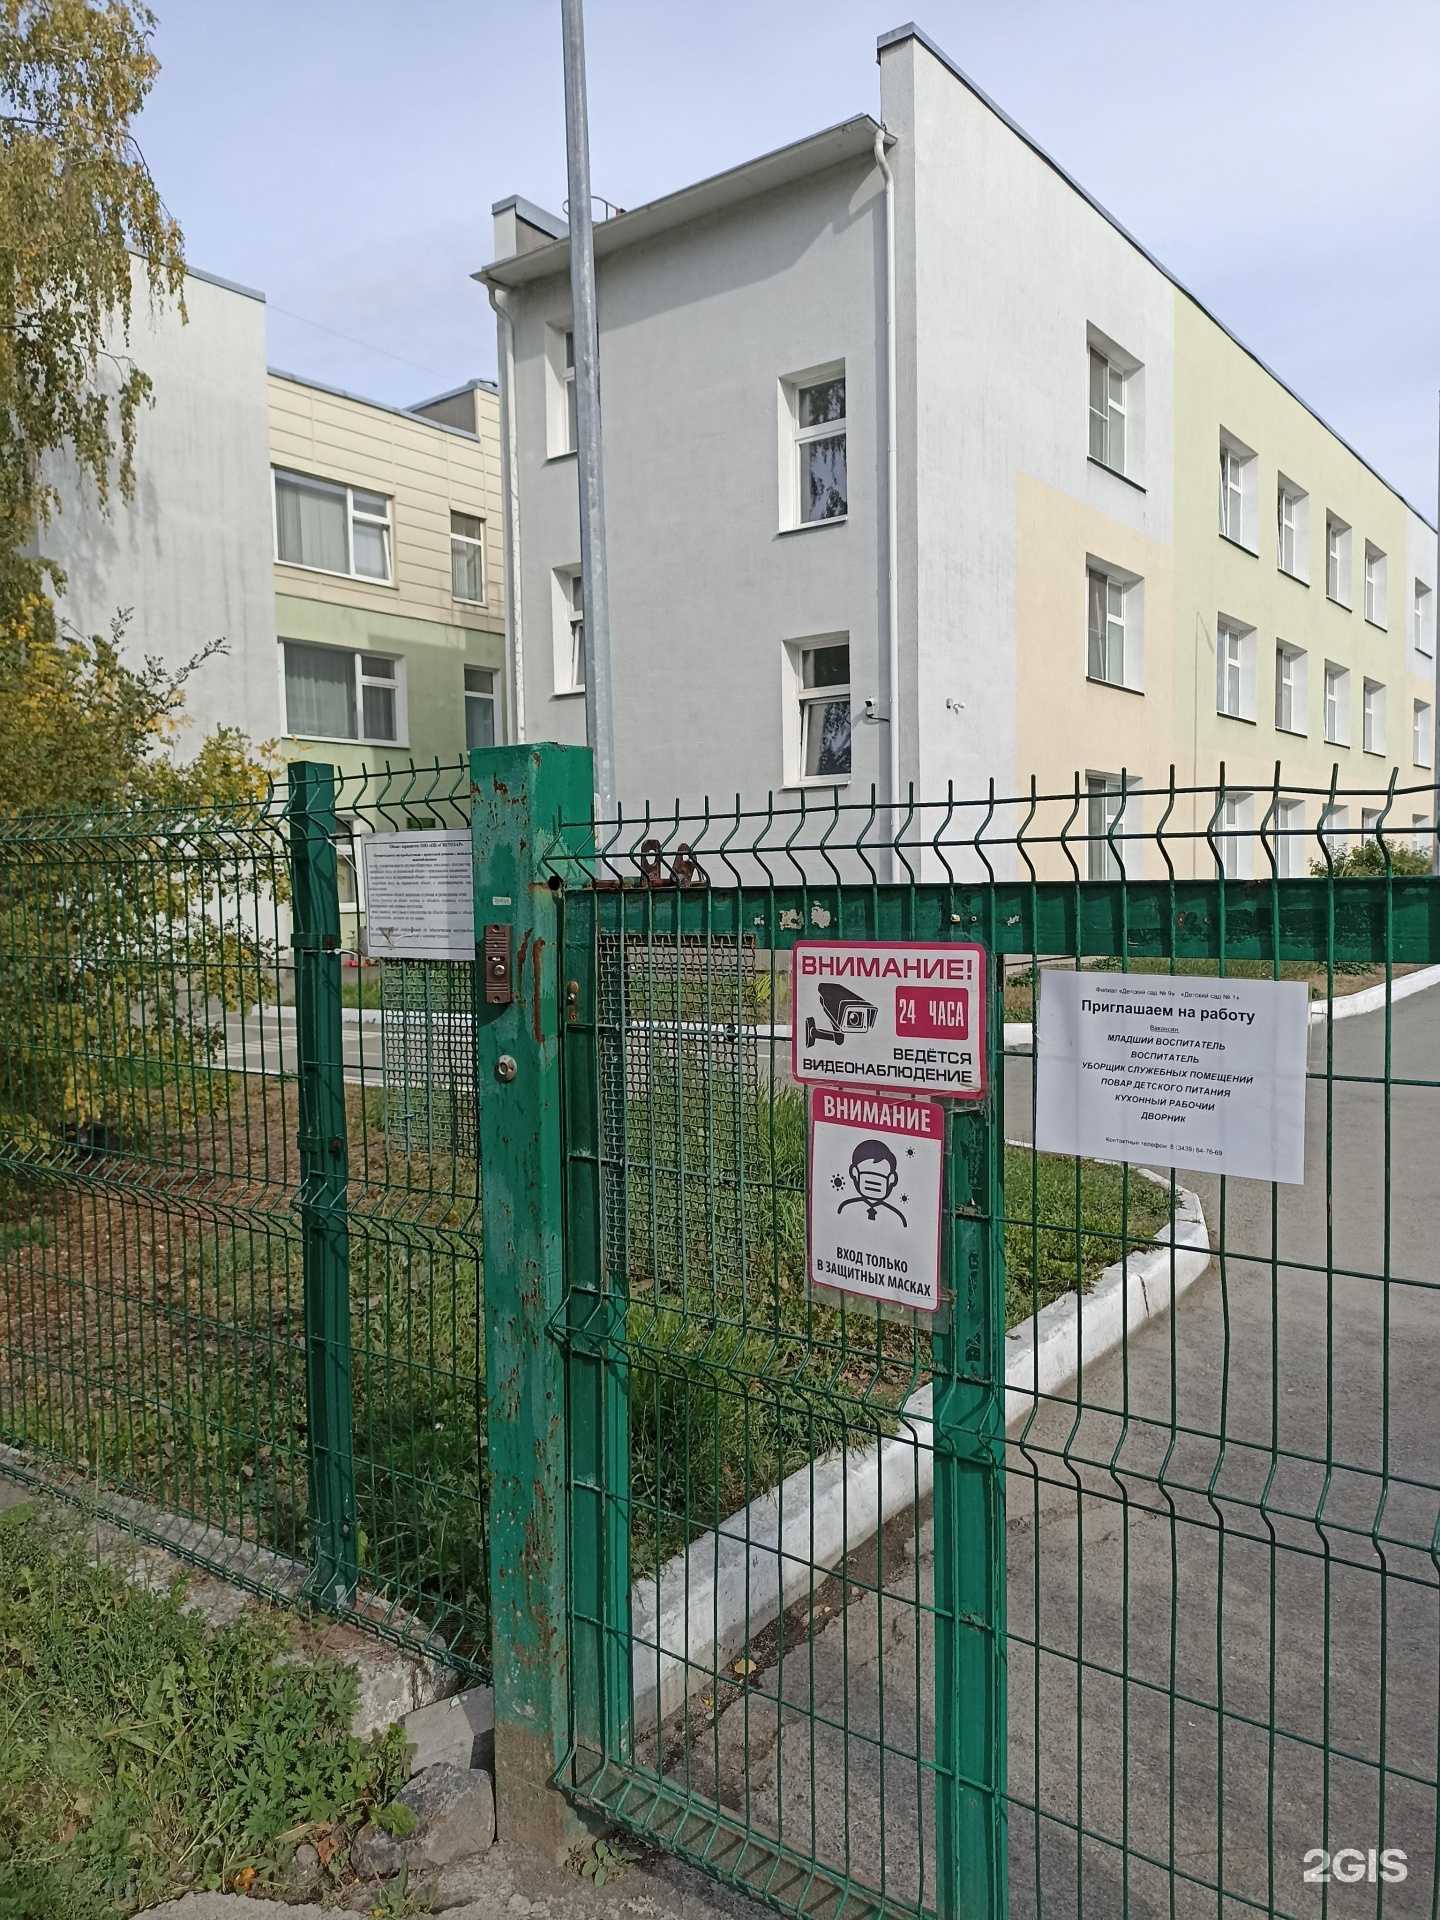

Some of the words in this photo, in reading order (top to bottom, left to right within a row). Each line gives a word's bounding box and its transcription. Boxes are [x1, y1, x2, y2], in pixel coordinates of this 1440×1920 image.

[802, 955, 973, 981] ВНИМАНИЕ!
[899, 998, 917, 1025] 24
[929, 999, 965, 1027] ЧАСА
[1081, 999, 1174, 1018] Приглашаем
[1178, 1006, 1196, 1018] на
[1200, 1007, 1256, 1025] работу
[893, 1047, 972, 1065] ВЕДЁТСЯ
[1155, 1037, 1226, 1051] ВОСПИТАТЕЛЬ
[1130, 1050, 1200, 1064] ВОСПИТАТЕЛЬ
[803, 1059, 973, 1083] ВИДЕОНАБЛЮДЕНИЕ
[1082, 1061, 1126, 1074] УБОРЩИК
[1127, 1065, 1188, 1079] СЛУЖЕБНЫХ
[1101, 1077, 1133, 1089] ПОВАР
[1133, 1080, 1183, 1093] ДЕТСКОГО
[1185, 1085, 1232, 1098] ПИТАНИЯ
[823, 1095, 931, 1133] ВНИМАНИЕ
[1141, 1111, 1186, 1123] ДВОРНИК
[836, 1246, 863, 1265] ВХОД
[865, 1253, 908, 1273] ТОЛЬКО
[817, 1259, 824, 1271] В
[825, 1260, 885, 1286] ЗАЩИТНЫХ
[887, 1277, 931, 1297] МАСКАХ
